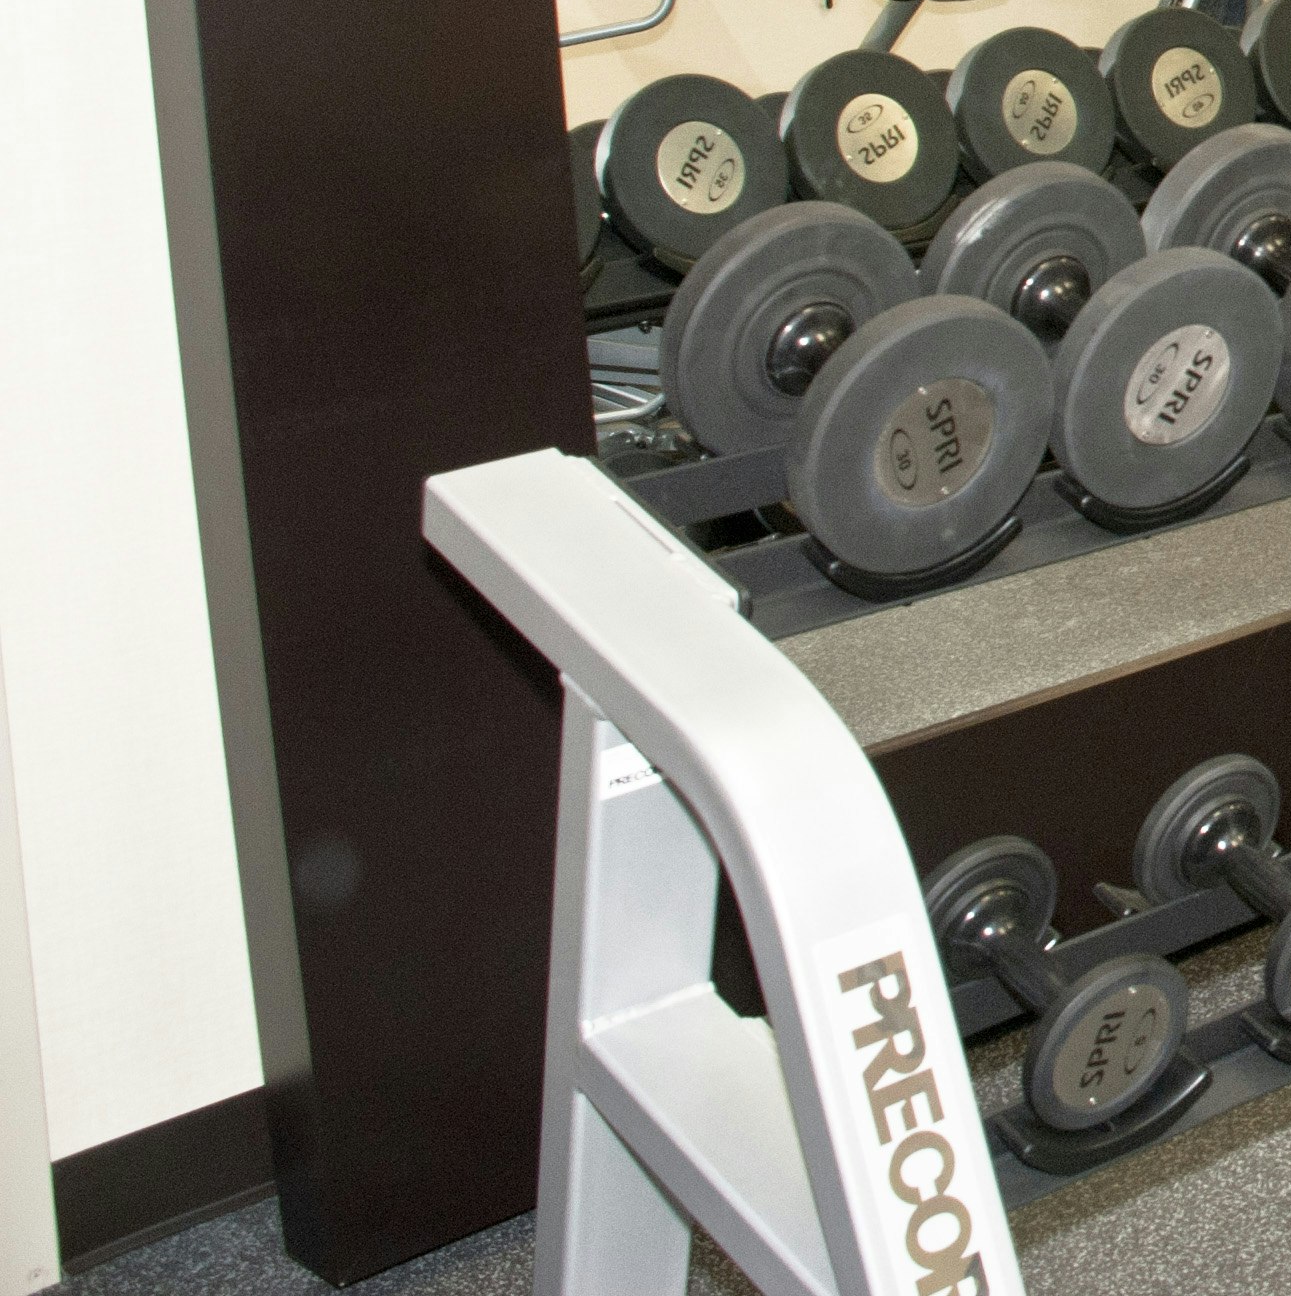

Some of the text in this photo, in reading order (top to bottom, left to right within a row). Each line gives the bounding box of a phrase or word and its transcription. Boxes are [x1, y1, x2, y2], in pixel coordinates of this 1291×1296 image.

[1158, 349, 1213, 426] SPRI
[925, 397, 963, 475] SPRI
[608, 769, 656, 789] PRECO
[1079, 1010, 1125, 1090] SPRI
